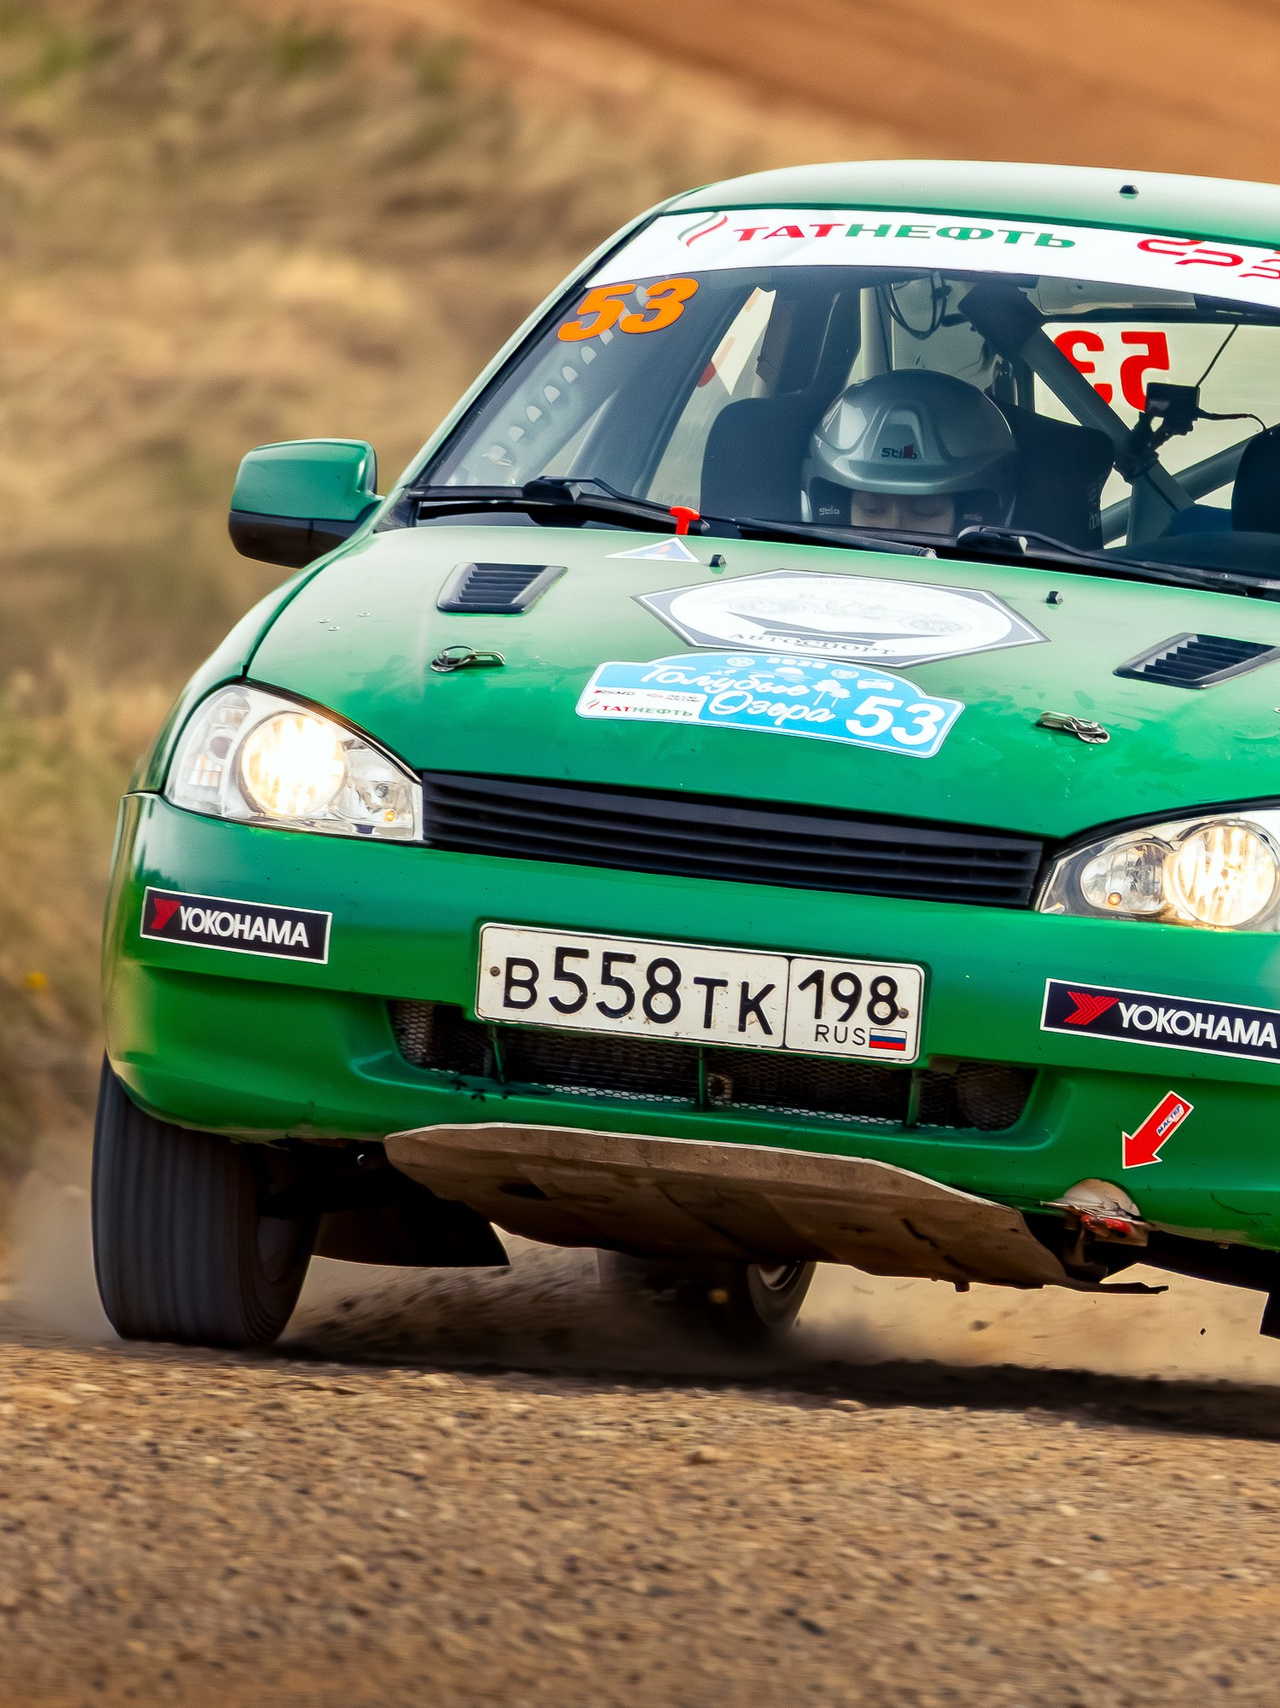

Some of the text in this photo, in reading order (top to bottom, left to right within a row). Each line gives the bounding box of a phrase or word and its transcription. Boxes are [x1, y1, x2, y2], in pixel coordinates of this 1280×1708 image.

[732, 222, 1077, 249] ТАТНЕФТЬ
[556, 277, 699, 343] 53
[640, 663, 811, 697] Голубые
[602, 704, 694, 717] ТАТНЕФТЬ
[708, 690, 836, 726] Озера
[845, 695, 946, 746] 53
[179, 905, 310, 948] YOKOHAMA
[796, 968, 903, 1026] 198
[813, 1024, 867, 1047] RUS
[1117, 1001, 1278, 1049] YOKOHAMA
